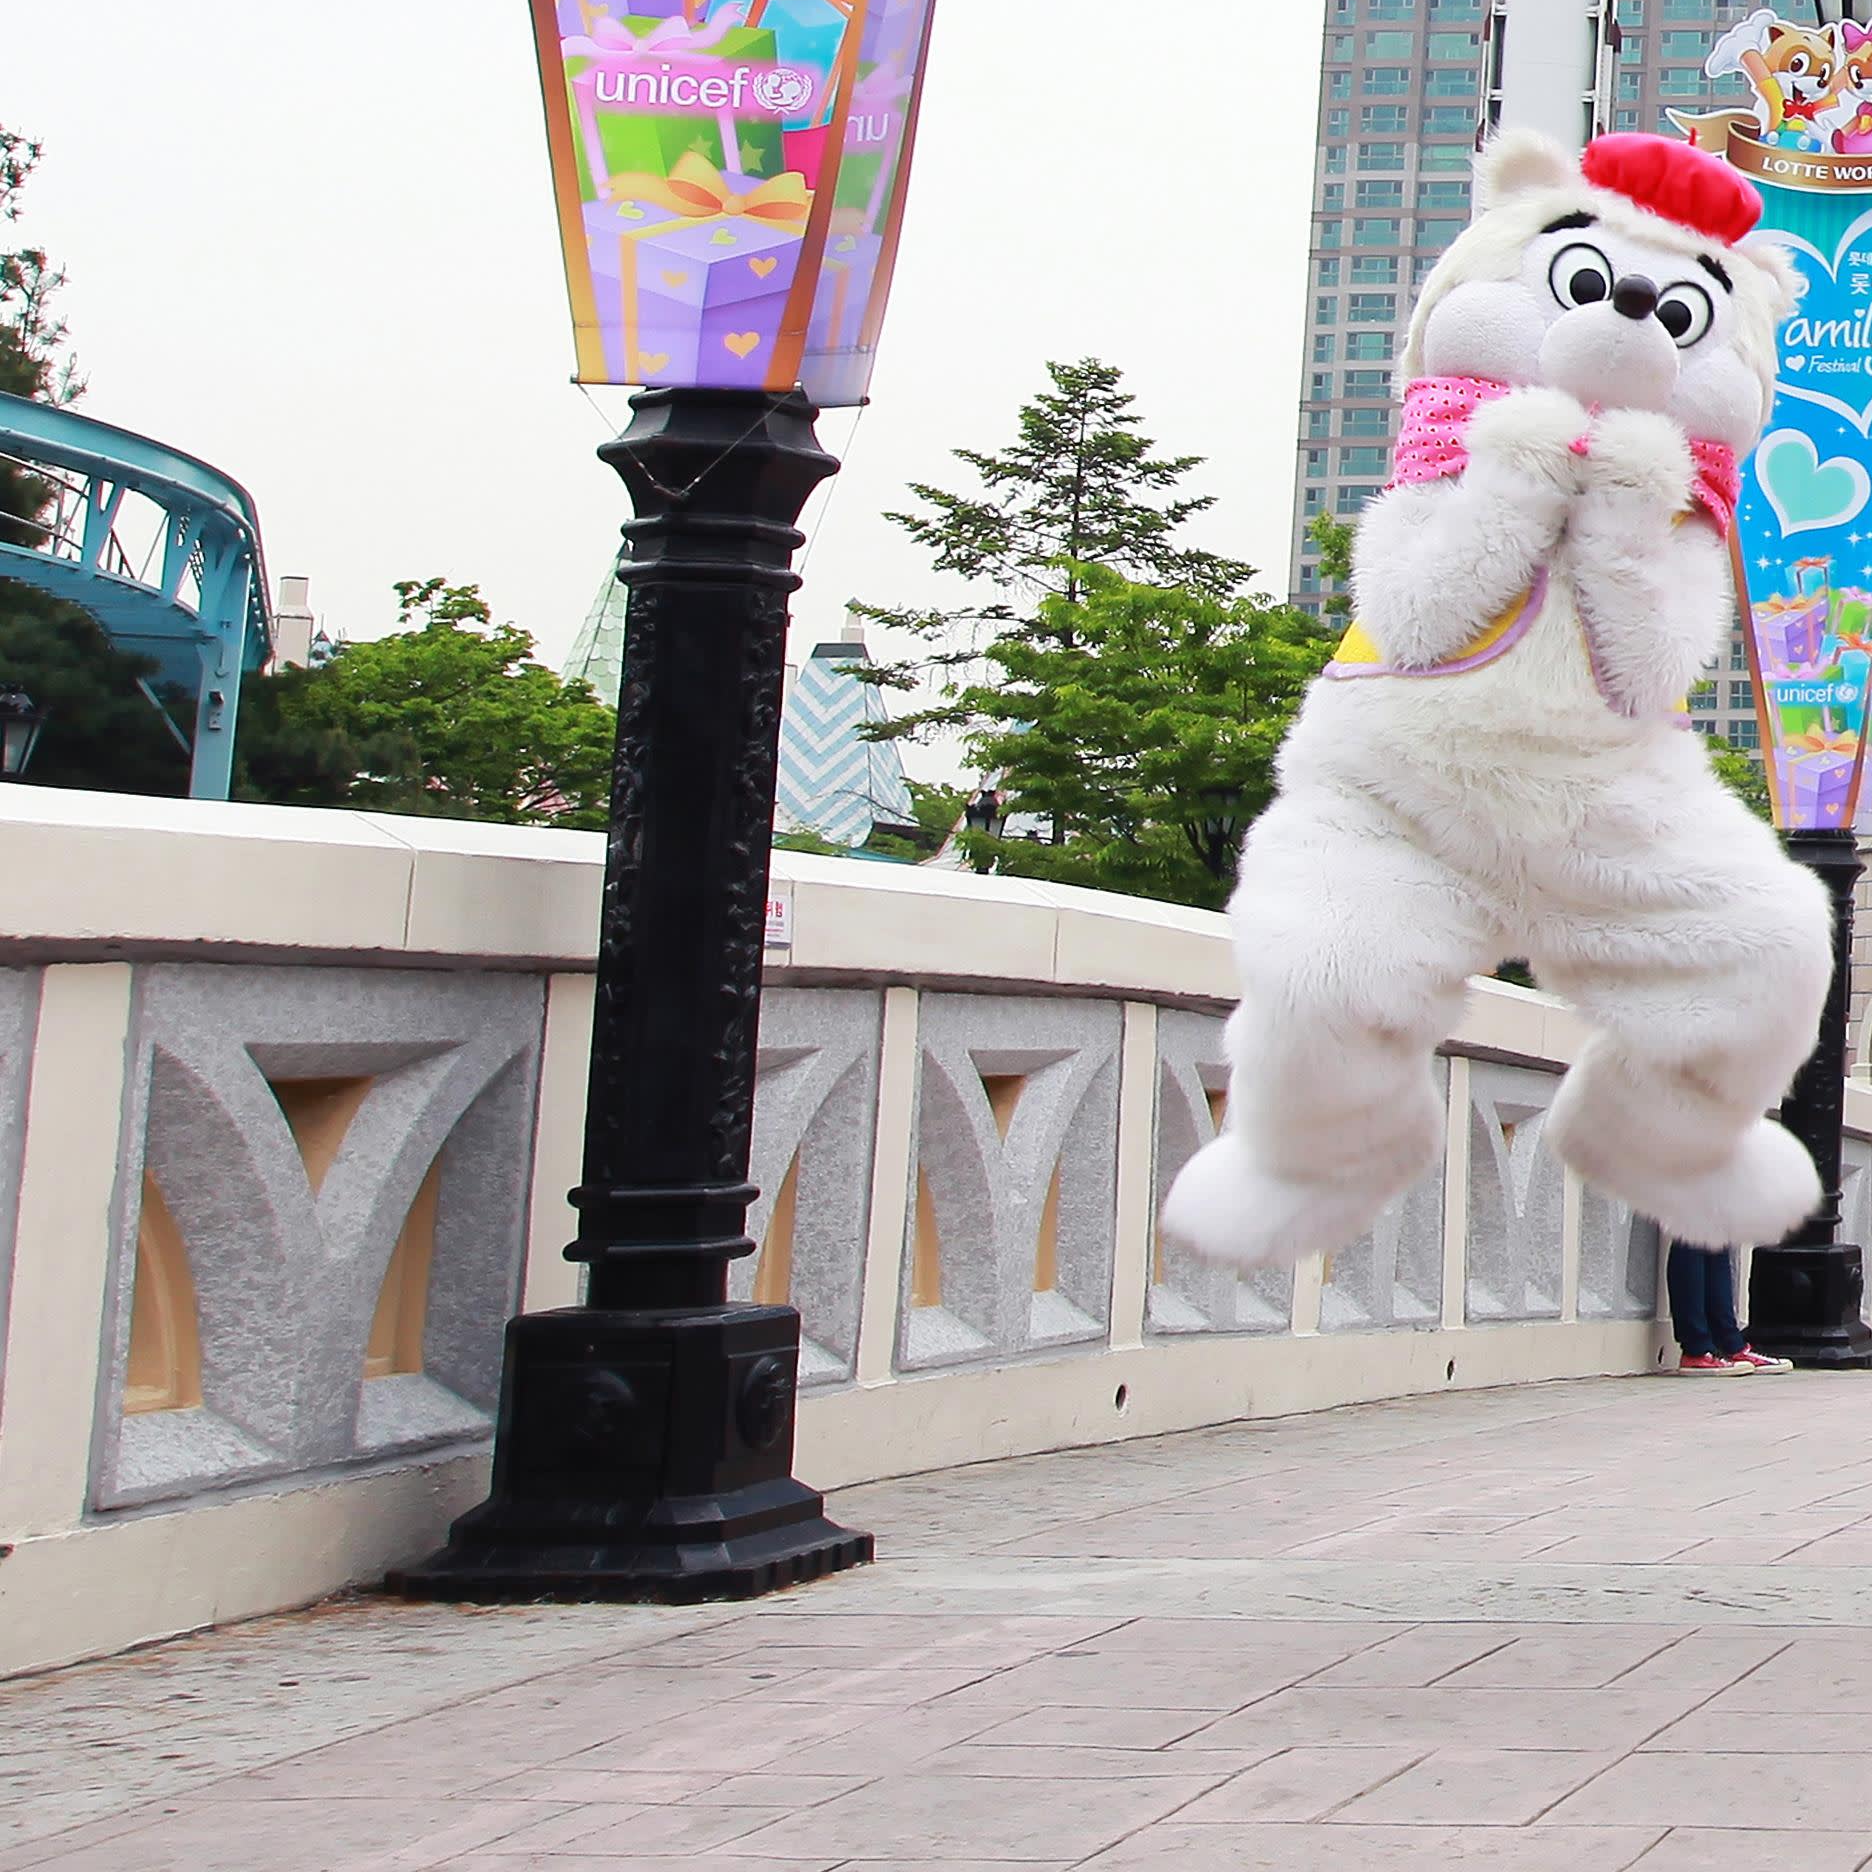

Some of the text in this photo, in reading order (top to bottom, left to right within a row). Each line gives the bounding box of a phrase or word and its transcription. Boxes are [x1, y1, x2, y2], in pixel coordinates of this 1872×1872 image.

[595, 63, 750, 108] unicef
[1762, 157, 1829, 180] LOTTE
[1776, 683, 1834, 703] unicef
